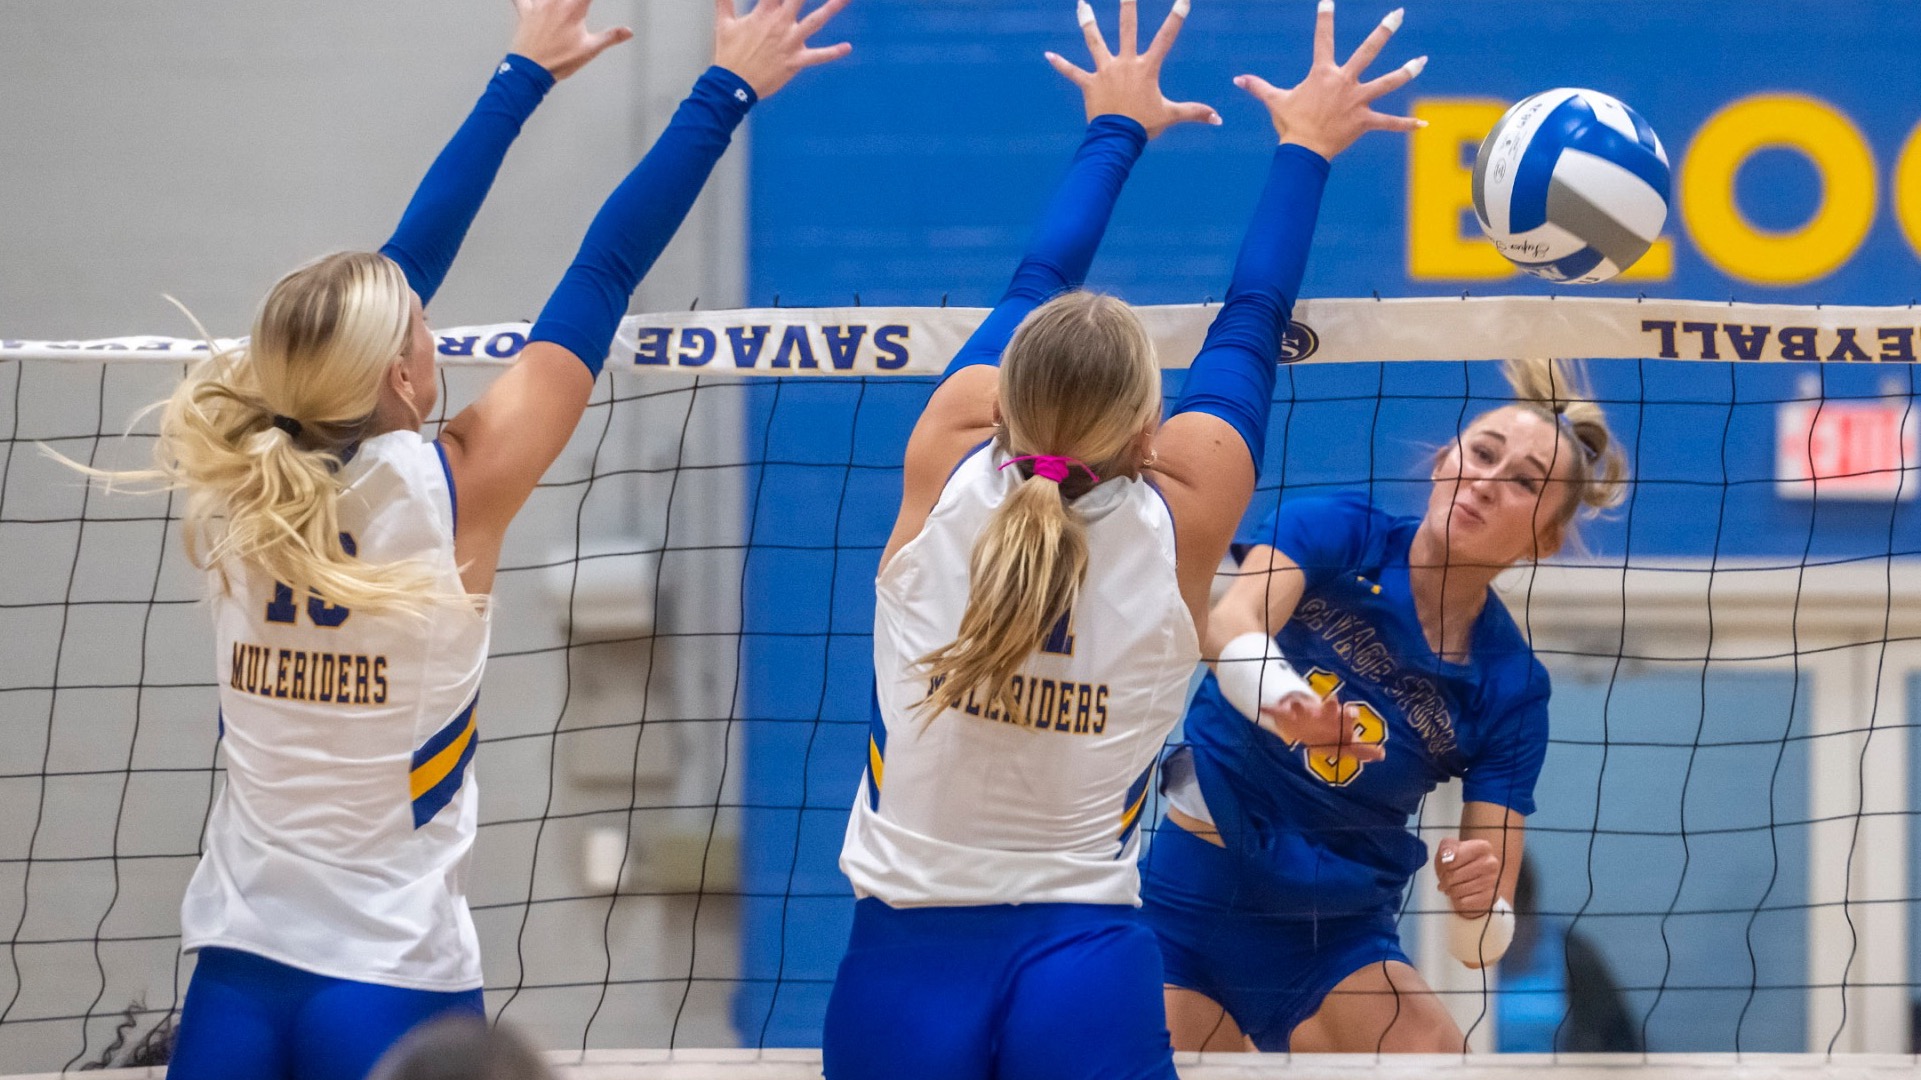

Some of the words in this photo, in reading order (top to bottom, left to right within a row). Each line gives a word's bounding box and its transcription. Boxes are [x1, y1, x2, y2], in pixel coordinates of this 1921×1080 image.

[633, 324, 910, 371] SAVAGE
[1641, 319, 1921, 363] EYBALL
[230, 641, 389, 705] MULERIDERS
